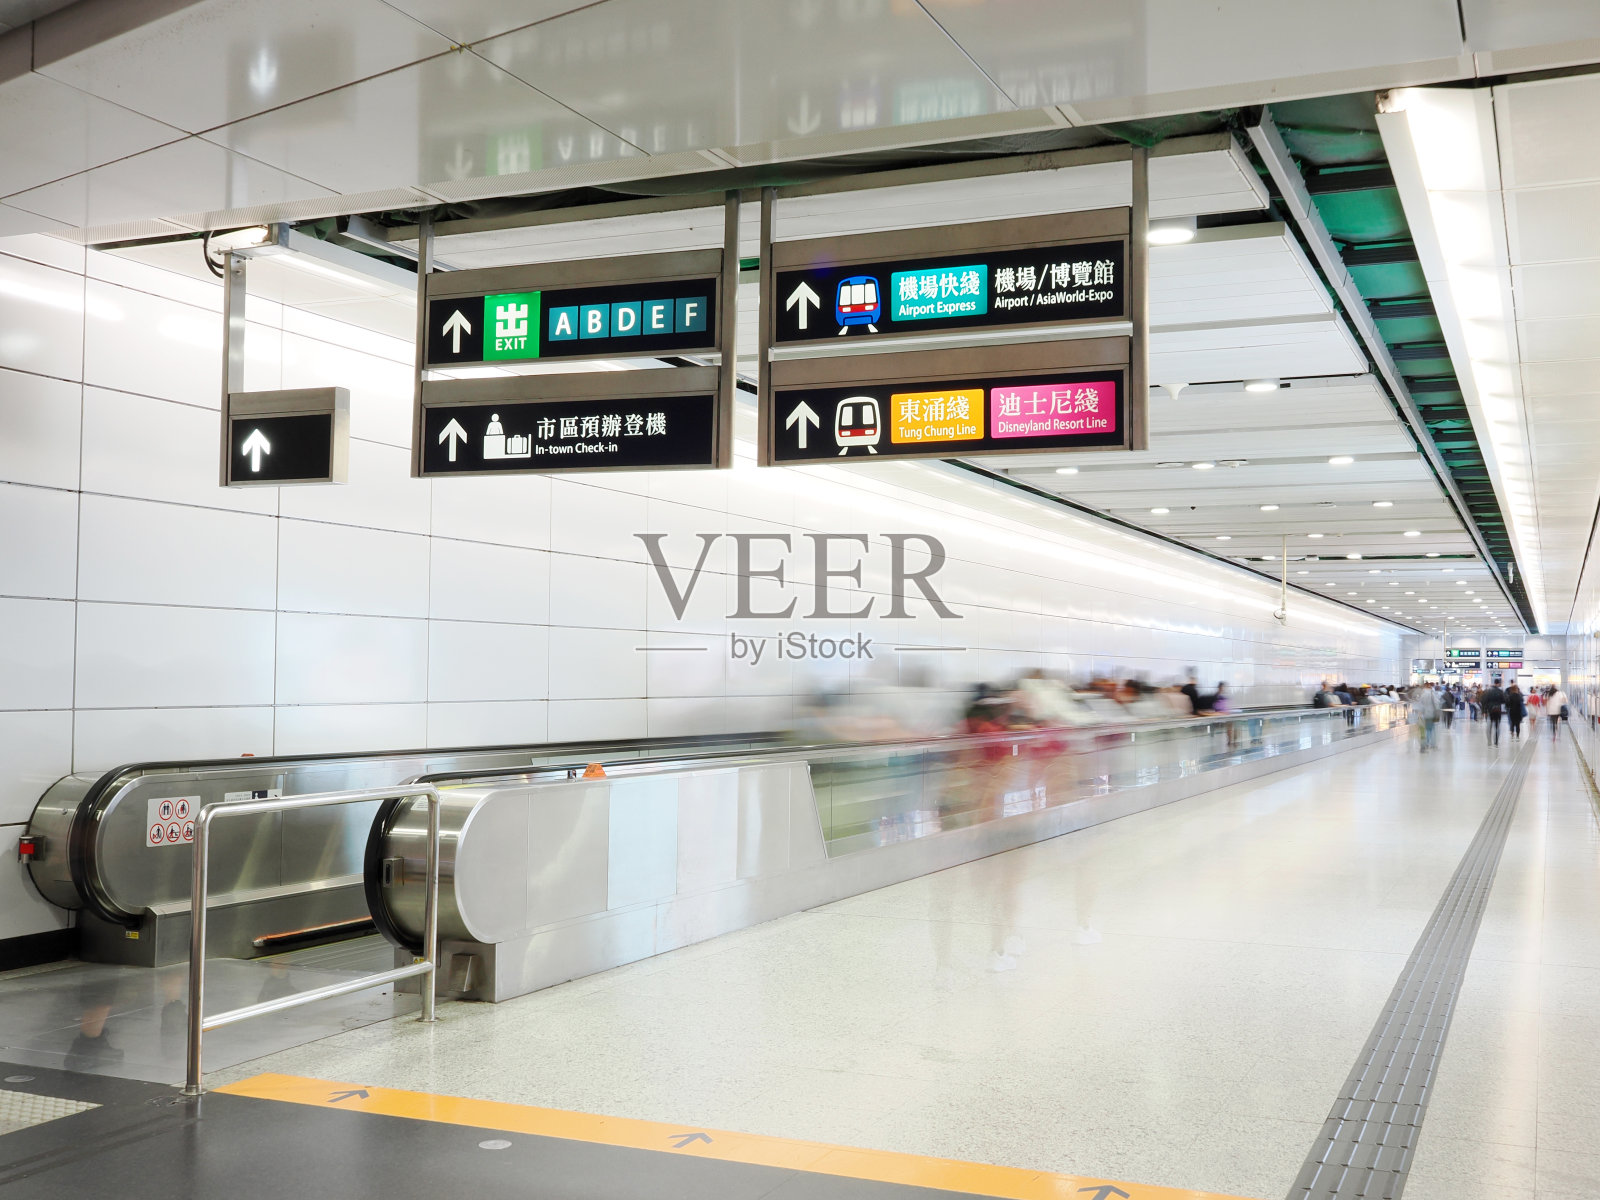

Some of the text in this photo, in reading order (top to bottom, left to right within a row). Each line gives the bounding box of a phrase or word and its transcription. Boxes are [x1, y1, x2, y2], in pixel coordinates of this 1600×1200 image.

[899, 271, 980, 302] 機場快綫
[995, 259, 1115, 294] 機場/博覽館
[899, 300, 976, 318] Airport Express
[995, 289, 1114, 310] Airport / AsiaWorld-Expo
[496, 303, 528, 337] 出
[555, 303, 698, 336] A B D E F
[496, 337, 528, 351] EXIT
[899, 395, 970, 424] 東涌綫
[998, 388, 1099, 418] 迪士尼綫
[536, 412, 667, 440] 市區預辦登機
[899, 423, 976, 440] Tung Chung Line
[998, 417, 1108, 434] Disneyland Resort Line
[536, 442, 618, 455] In-town Check-in
